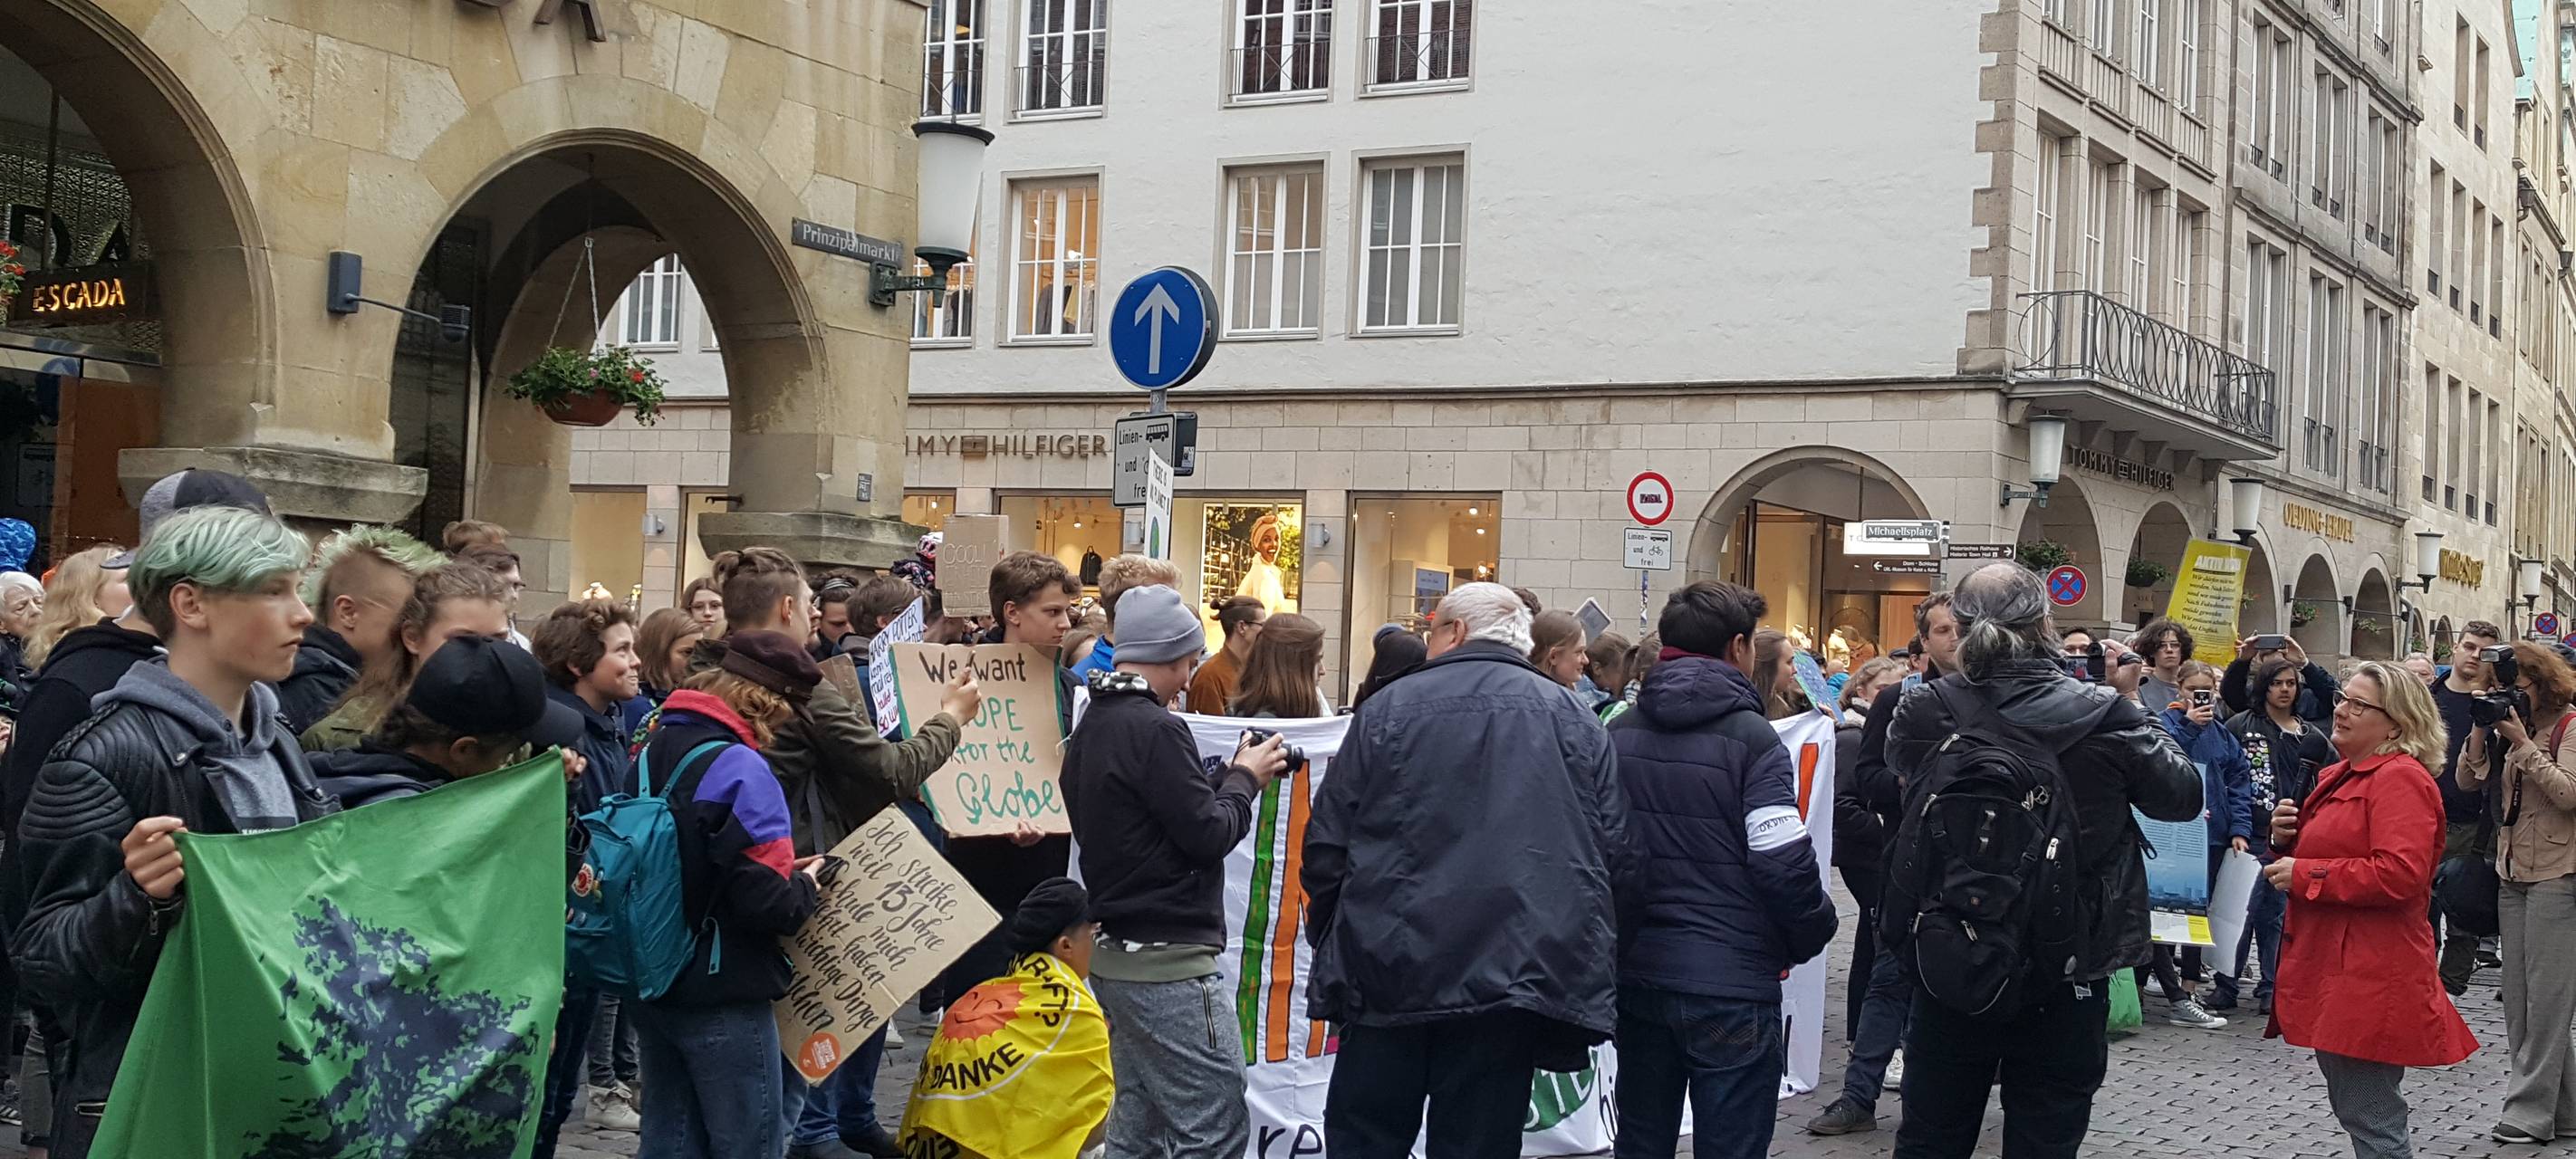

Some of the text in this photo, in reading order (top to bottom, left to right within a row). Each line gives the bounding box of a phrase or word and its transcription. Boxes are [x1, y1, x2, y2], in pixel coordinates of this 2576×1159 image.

[803, 224, 896, 263] Prinzipalmarkt
[32, 277, 125, 312] ESCADA
[993, 435, 1107, 458] HILFIGER
[1119, 428, 1143, 445] Linien-
[1124, 457, 1138, 473] und
[2069, 444, 2175, 491] TOMMY HILFIGER
[1134, 483, 1147, 498] fre
[1868, 526, 1933, 537] Michaelisplatz
[1640, 558, 1654, 566] frei
[892, 605, 918, 641] POTTER
[918, 652, 1027, 684] We want
[966, 696, 1024, 732] OPE
[997, 736, 1035, 764] the
[956, 770, 1062, 825] Globe
[849, 841, 945, 951] weil 13 Jahre
[842, 934, 886, 989] haben
[870, 925, 917, 972] mich
[795, 928, 848, 991] wichtige
[834, 977, 879, 1034] Dinge
